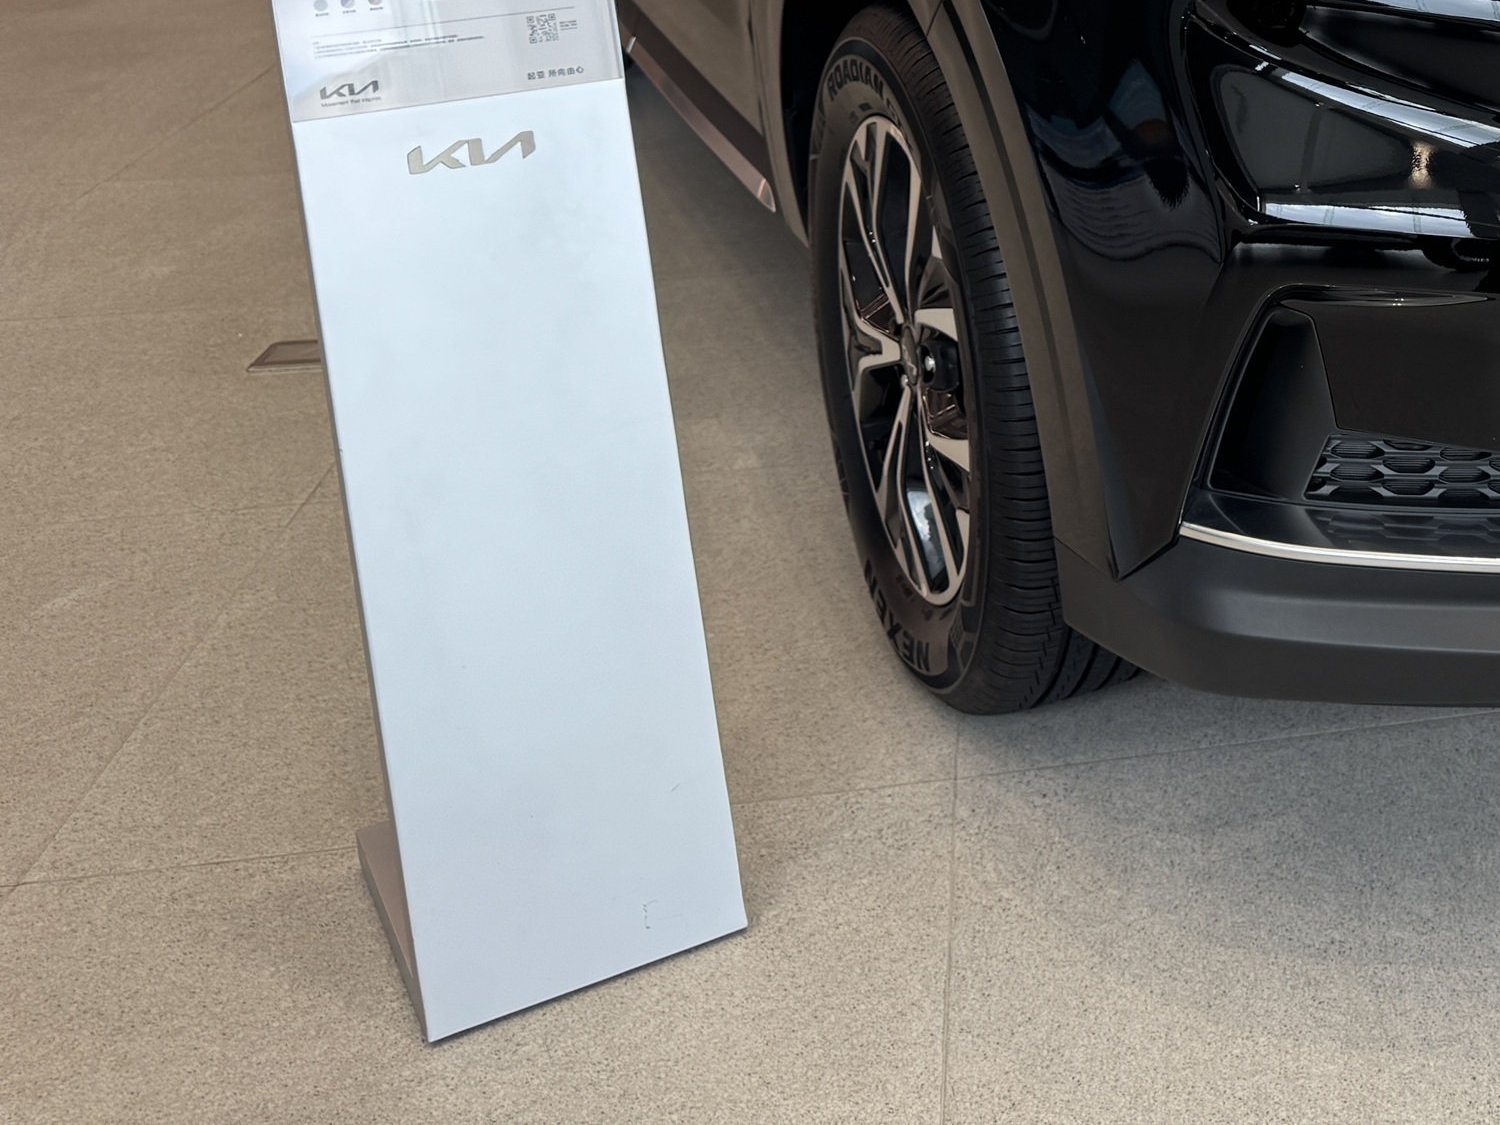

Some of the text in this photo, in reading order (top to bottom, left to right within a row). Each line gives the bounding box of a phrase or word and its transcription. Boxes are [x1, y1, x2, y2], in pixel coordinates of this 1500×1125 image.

[320, 79, 379, 100] KIA
[827, 58, 885, 102] ROADIAN
[407, 130, 536, 175] KIA
